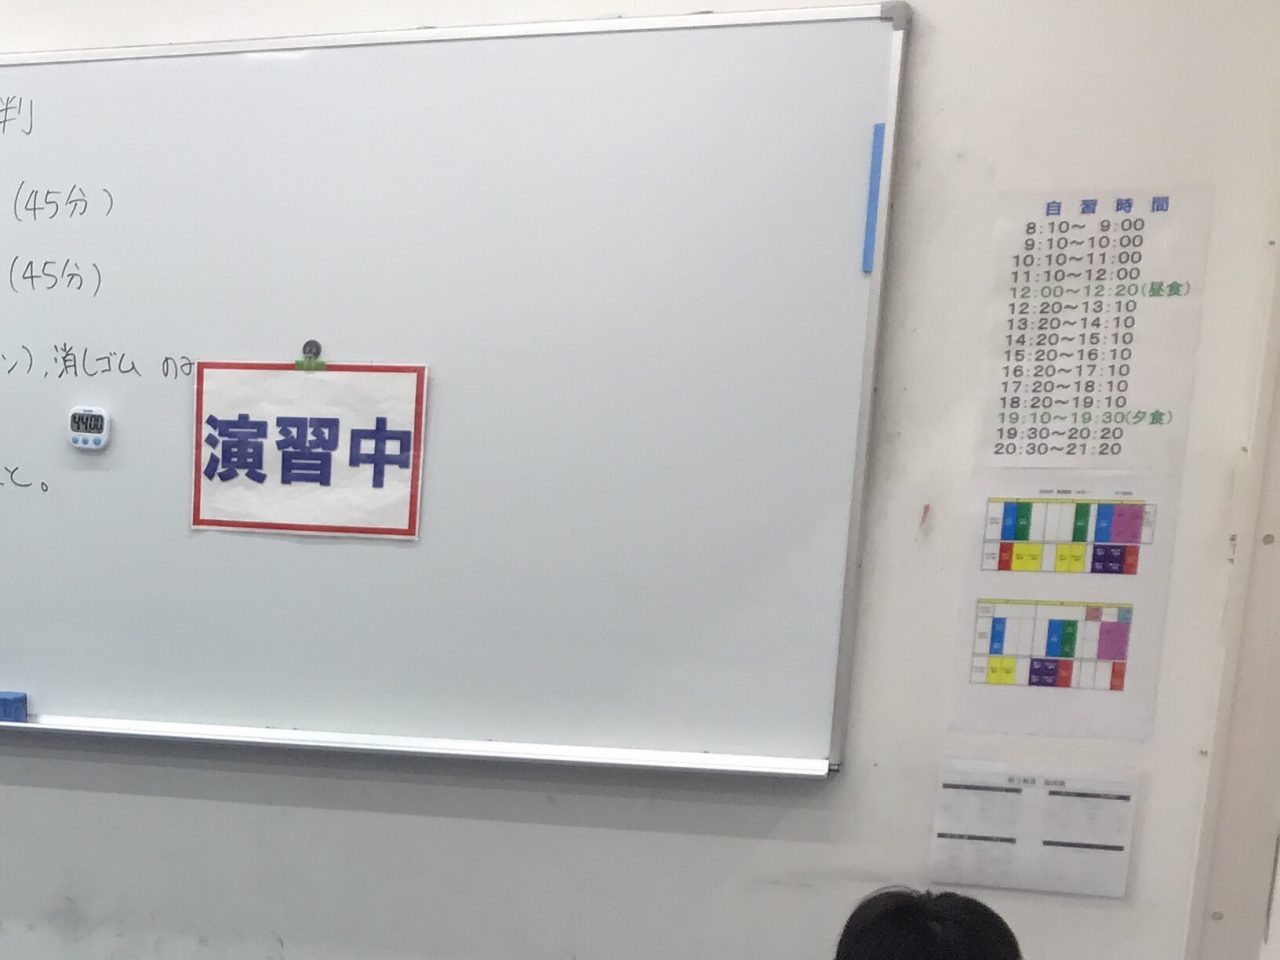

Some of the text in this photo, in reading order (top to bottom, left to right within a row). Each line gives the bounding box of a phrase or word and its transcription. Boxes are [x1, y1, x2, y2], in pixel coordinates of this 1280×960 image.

[1045, 196, 1170, 216] 自習時間
[203, 413, 413, 489] 演習中
